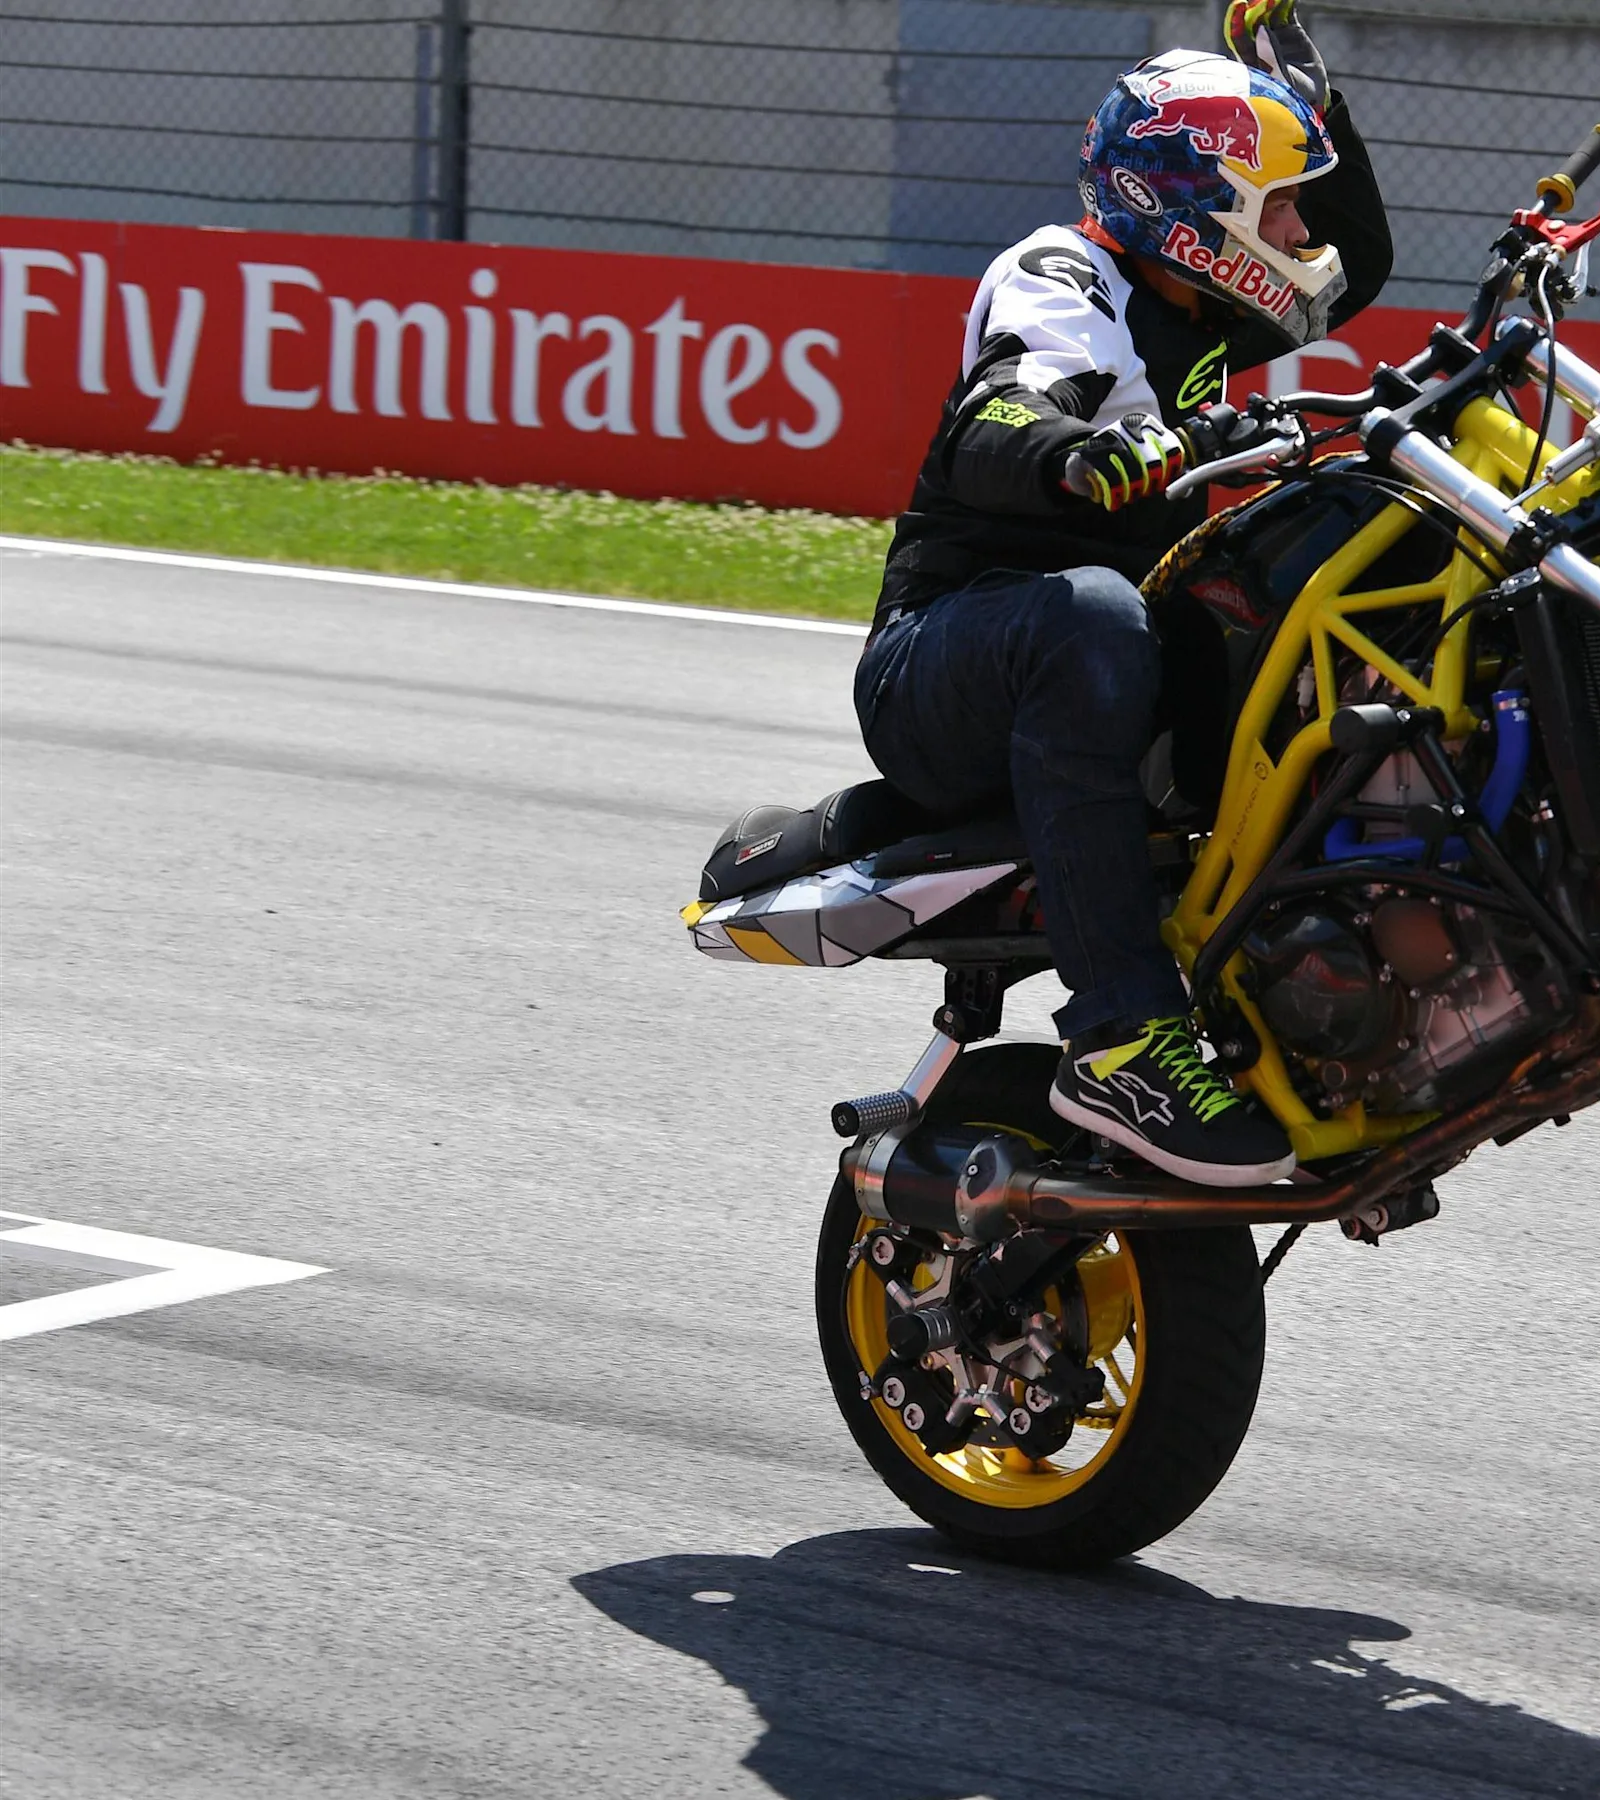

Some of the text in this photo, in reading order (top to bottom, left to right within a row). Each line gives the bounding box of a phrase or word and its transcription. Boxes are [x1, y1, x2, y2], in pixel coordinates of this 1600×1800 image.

[1119, 174, 1153, 209] LAZER
[0, 247, 841, 449] Fly Emirates
